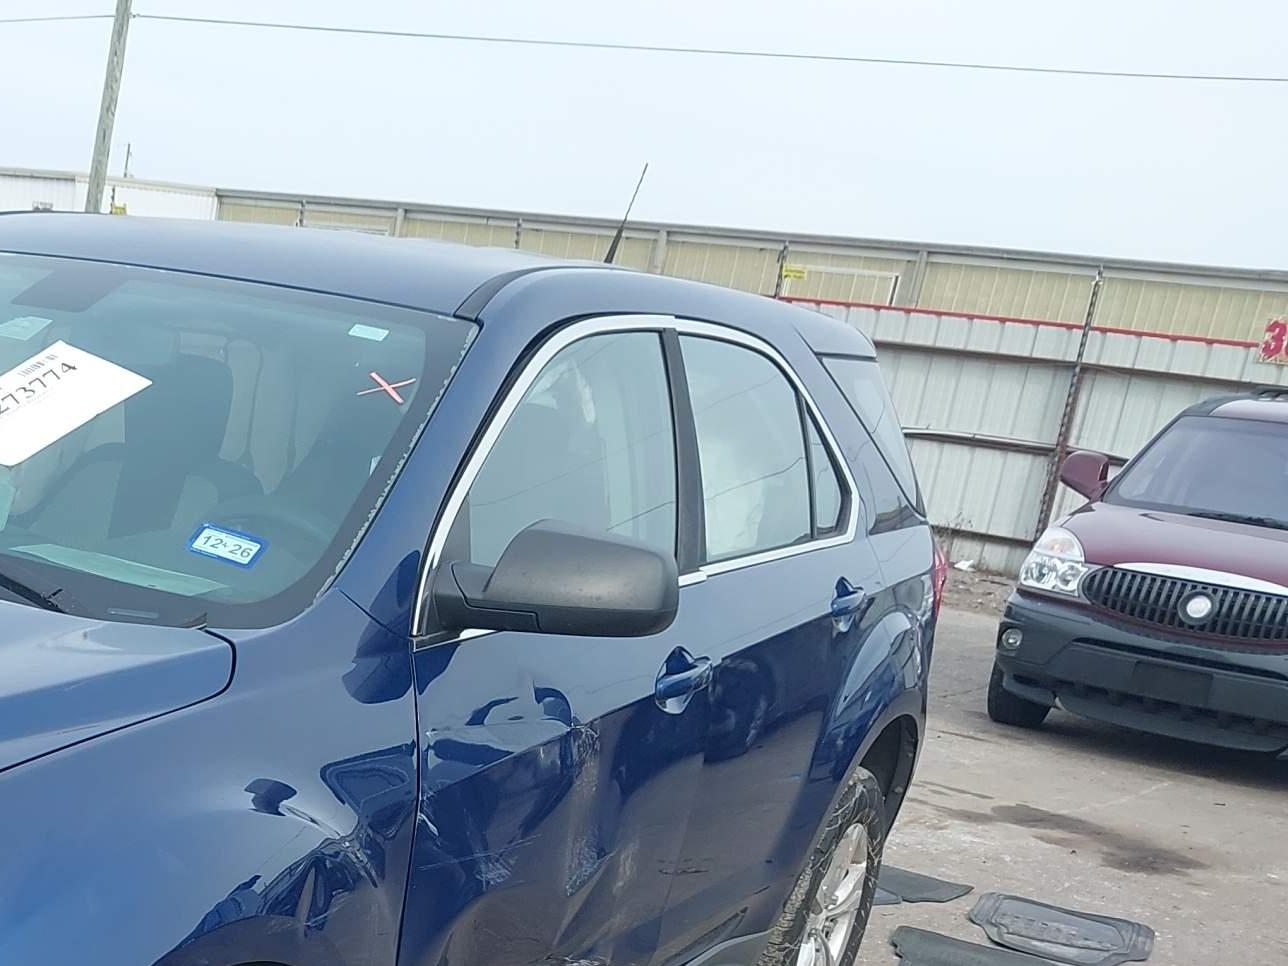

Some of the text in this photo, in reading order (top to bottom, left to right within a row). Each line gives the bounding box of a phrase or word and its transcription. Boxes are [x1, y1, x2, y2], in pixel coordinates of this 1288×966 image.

[1261, 320, 1288, 360] 3
[203, 535, 253, 559] 12 26
